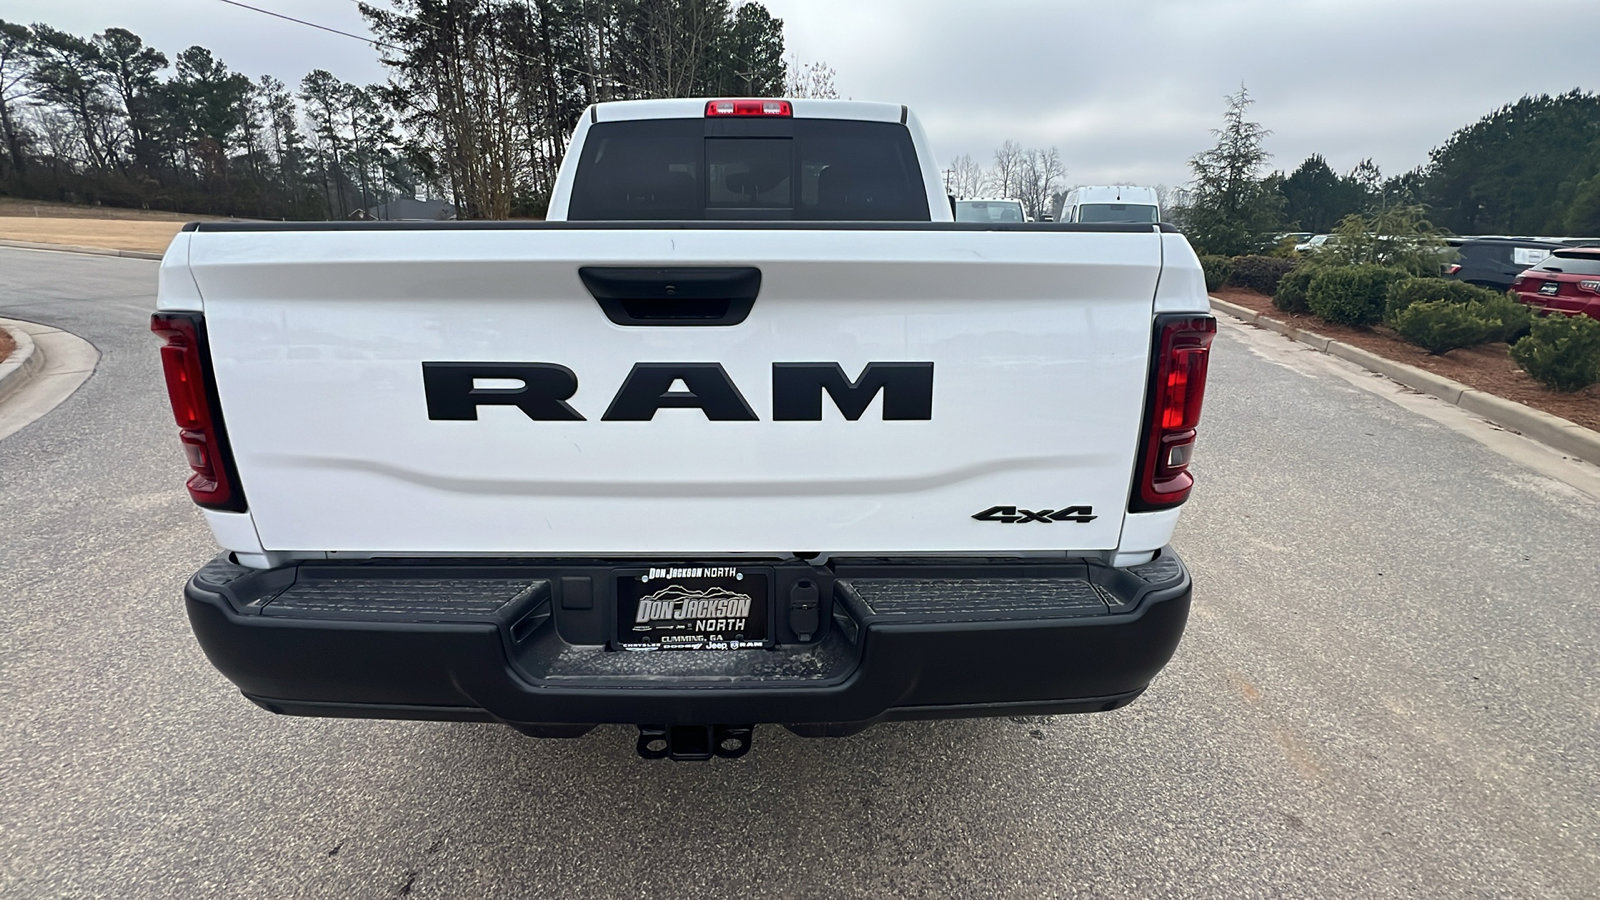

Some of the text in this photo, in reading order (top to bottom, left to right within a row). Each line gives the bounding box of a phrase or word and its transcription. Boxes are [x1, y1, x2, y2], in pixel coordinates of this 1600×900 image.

[422, 362, 934, 421] RAM
[971, 505, 1098, 523] 4x4
[649, 567, 737, 580] DON JACKSON NORTH
[635, 598, 752, 623] DON JACKSON
[695, 619, 746, 632] NORTH
[705, 641, 727, 650] Jeep
